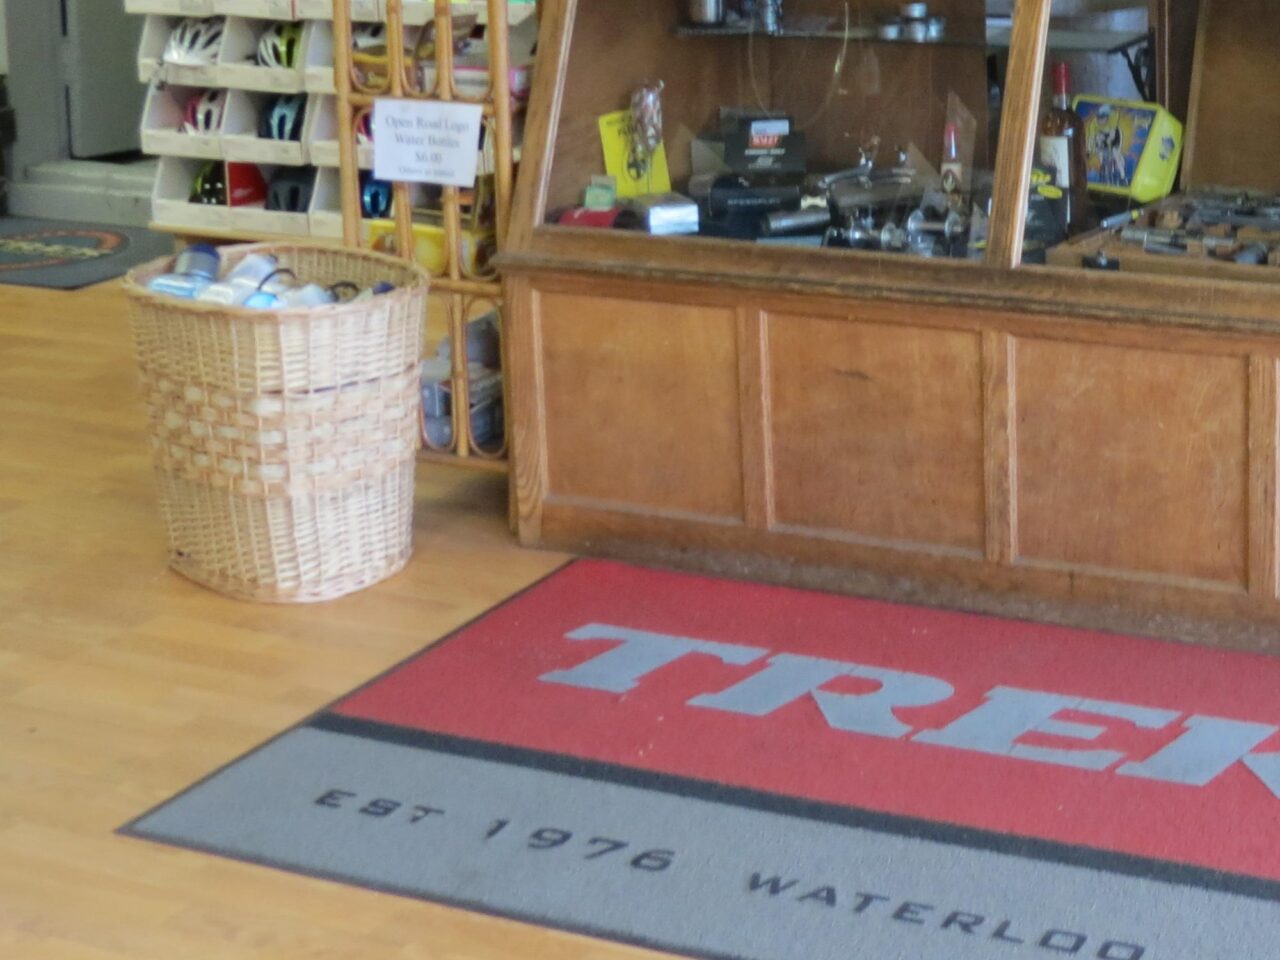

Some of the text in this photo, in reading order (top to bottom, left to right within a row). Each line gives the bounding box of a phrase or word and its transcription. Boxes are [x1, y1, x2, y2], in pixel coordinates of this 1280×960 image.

[386, 115, 470, 133] Open Road Logo
[313, 788, 1147, 960] EST 1976 WATERLOO
